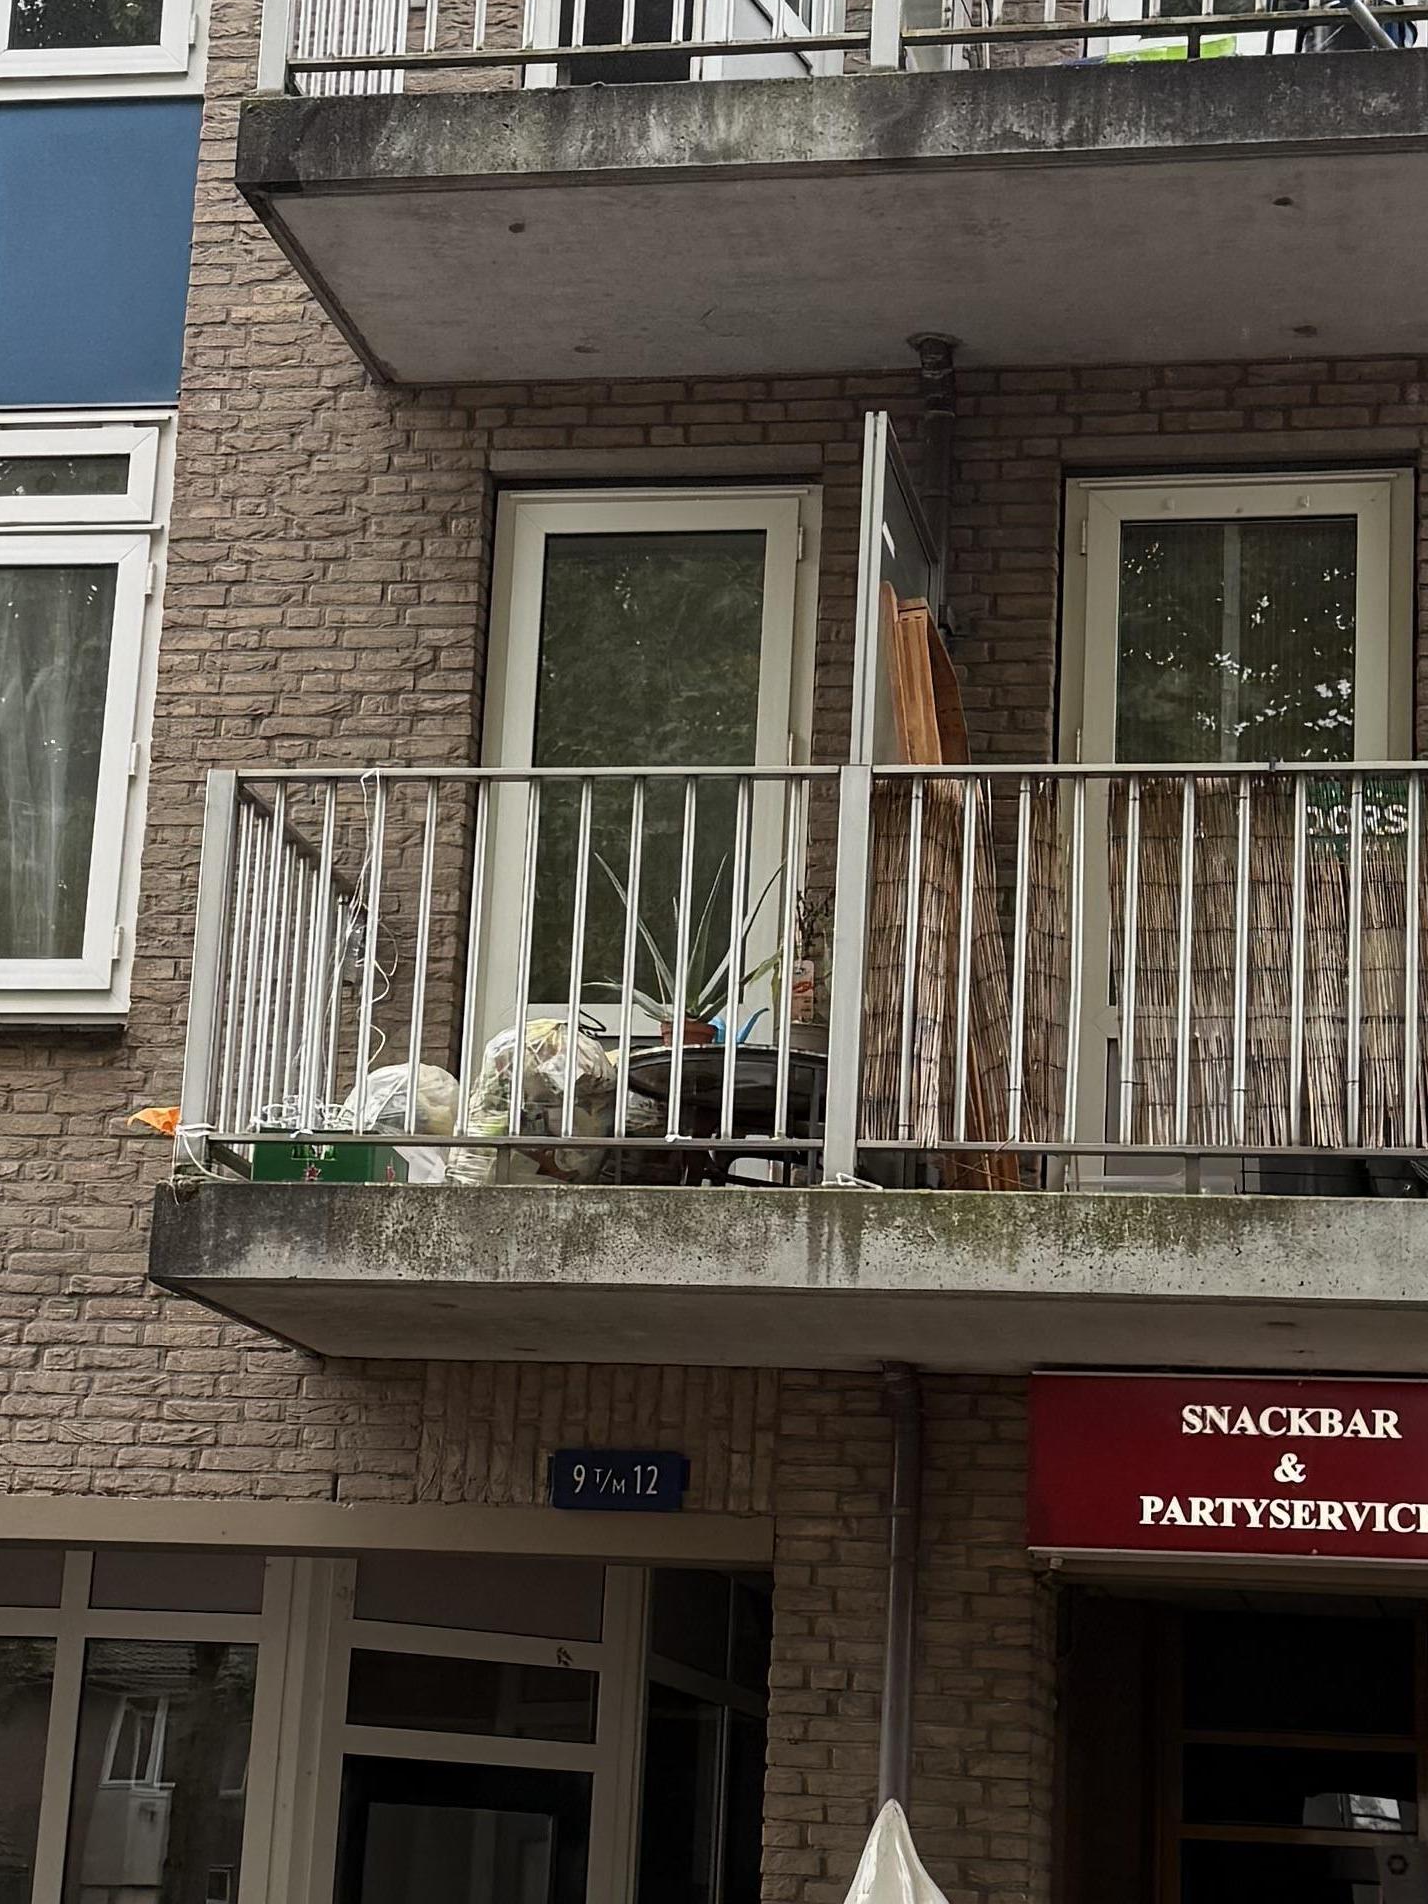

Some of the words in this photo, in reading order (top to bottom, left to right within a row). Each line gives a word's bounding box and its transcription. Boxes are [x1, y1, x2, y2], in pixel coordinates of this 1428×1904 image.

[1181, 1404, 1403, 1439] SNACKBAR
[573, 1464, 586, 1494] 9
[593, 1468, 625, 1495] T/M
[633, 1464, 659, 1495] 12
[1273, 1452, 1307, 1484] &
